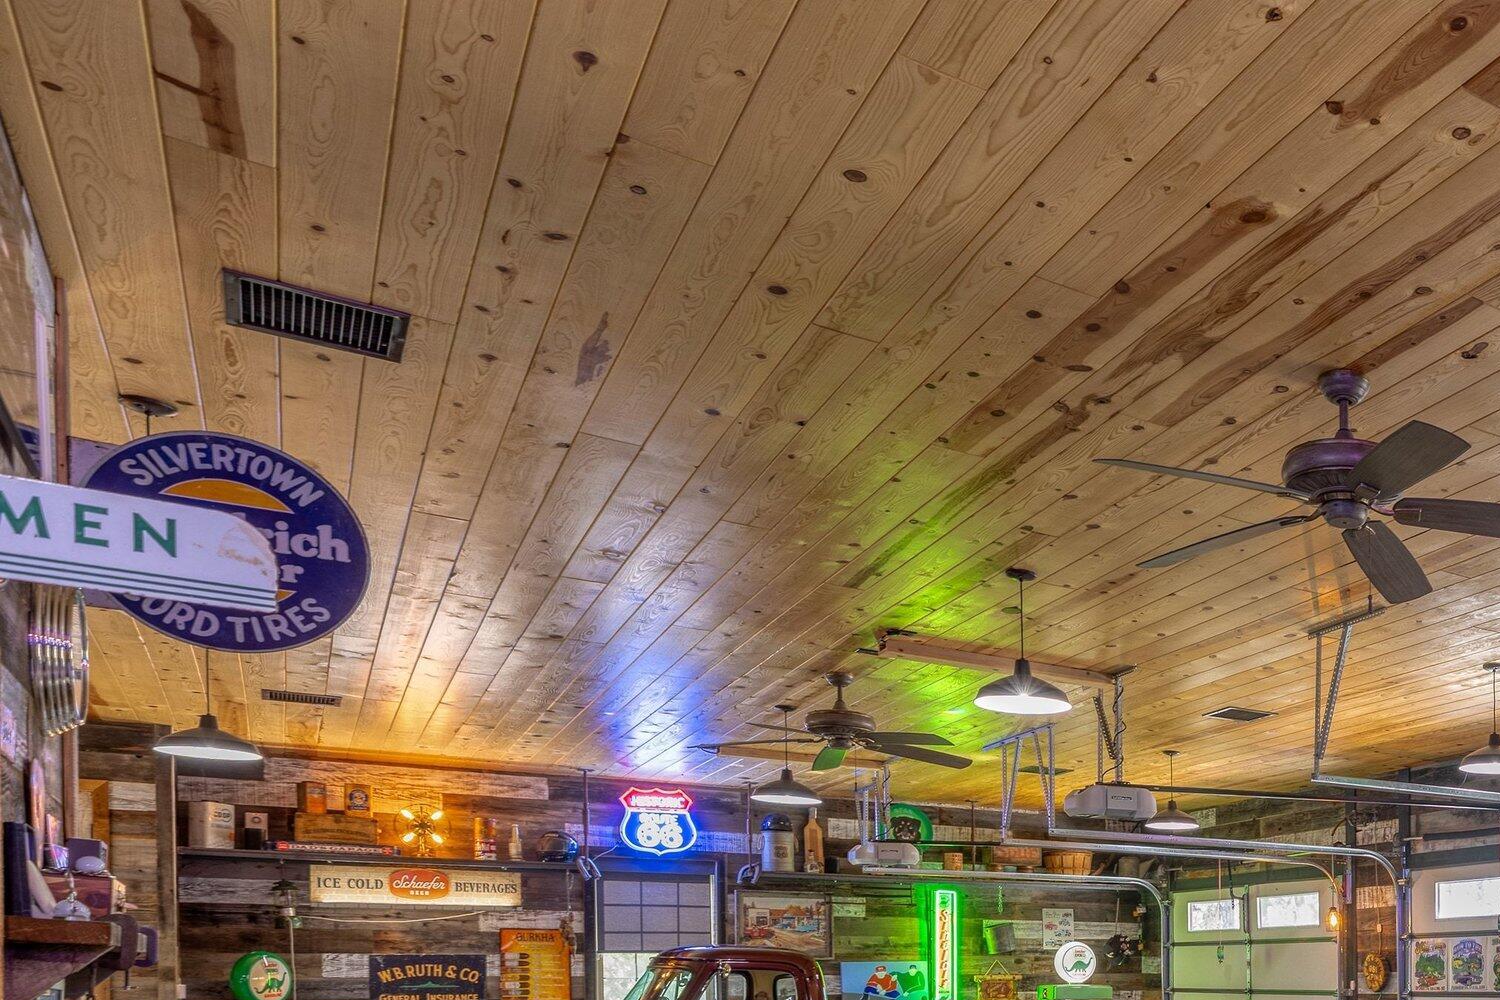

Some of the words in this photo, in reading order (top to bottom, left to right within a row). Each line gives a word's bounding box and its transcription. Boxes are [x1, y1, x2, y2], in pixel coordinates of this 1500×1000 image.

[118, 442, 325, 508] SILVERTOWN
[122, 592, 221, 637] ORD
[227, 597, 332, 643] TIRES
[317, 876, 341, 889] ICE
[347, 878, 384, 889] COLD
[392, 874, 446, 890] Schaefer
[455, 881, 518, 894] BEVERAGES
[445, 965, 457, 979] &
[460, 967, 481, 984] CO.
